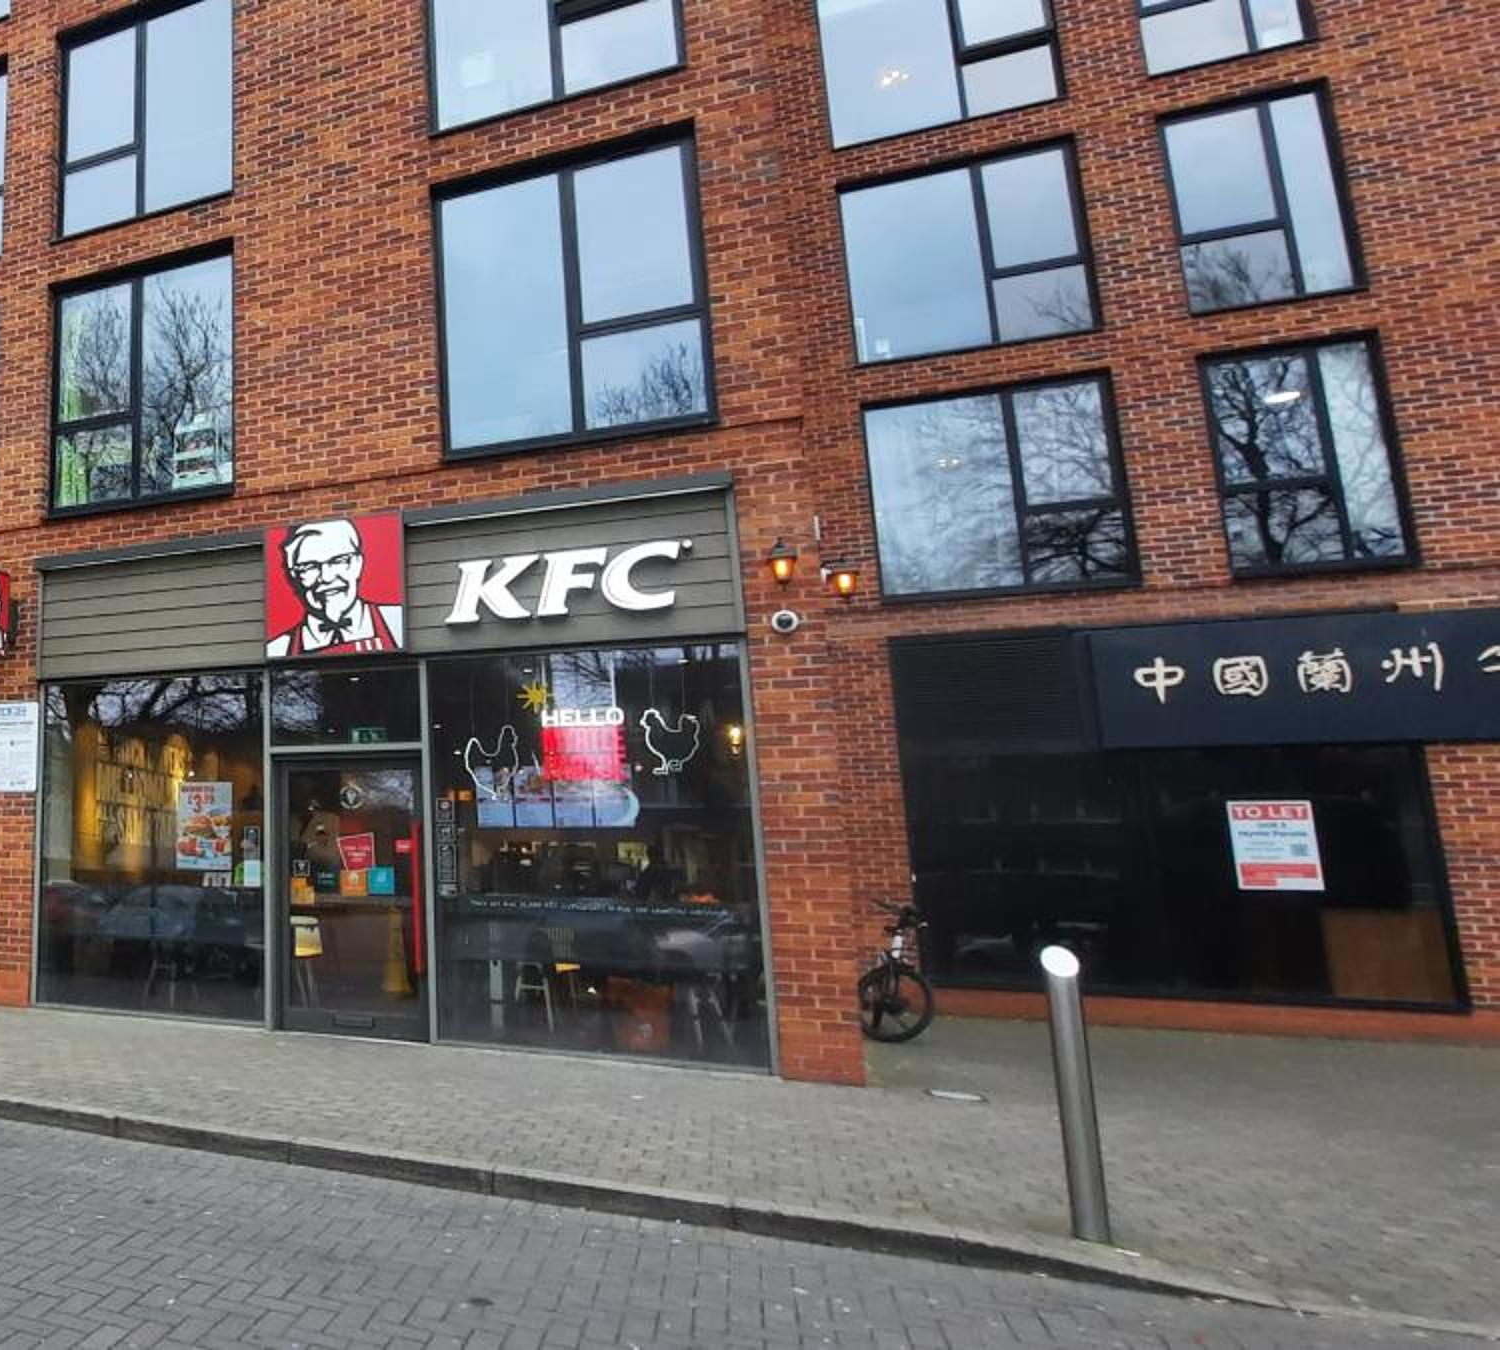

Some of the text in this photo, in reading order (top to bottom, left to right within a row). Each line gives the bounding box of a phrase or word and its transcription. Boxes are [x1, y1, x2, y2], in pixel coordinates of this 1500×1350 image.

[444, 541, 681, 624] KFC
[1134, 642, 1500, 704] 中國蘭州
[541, 706, 625, 727] HELLO
[1234, 804, 1307, 819] TO LET
